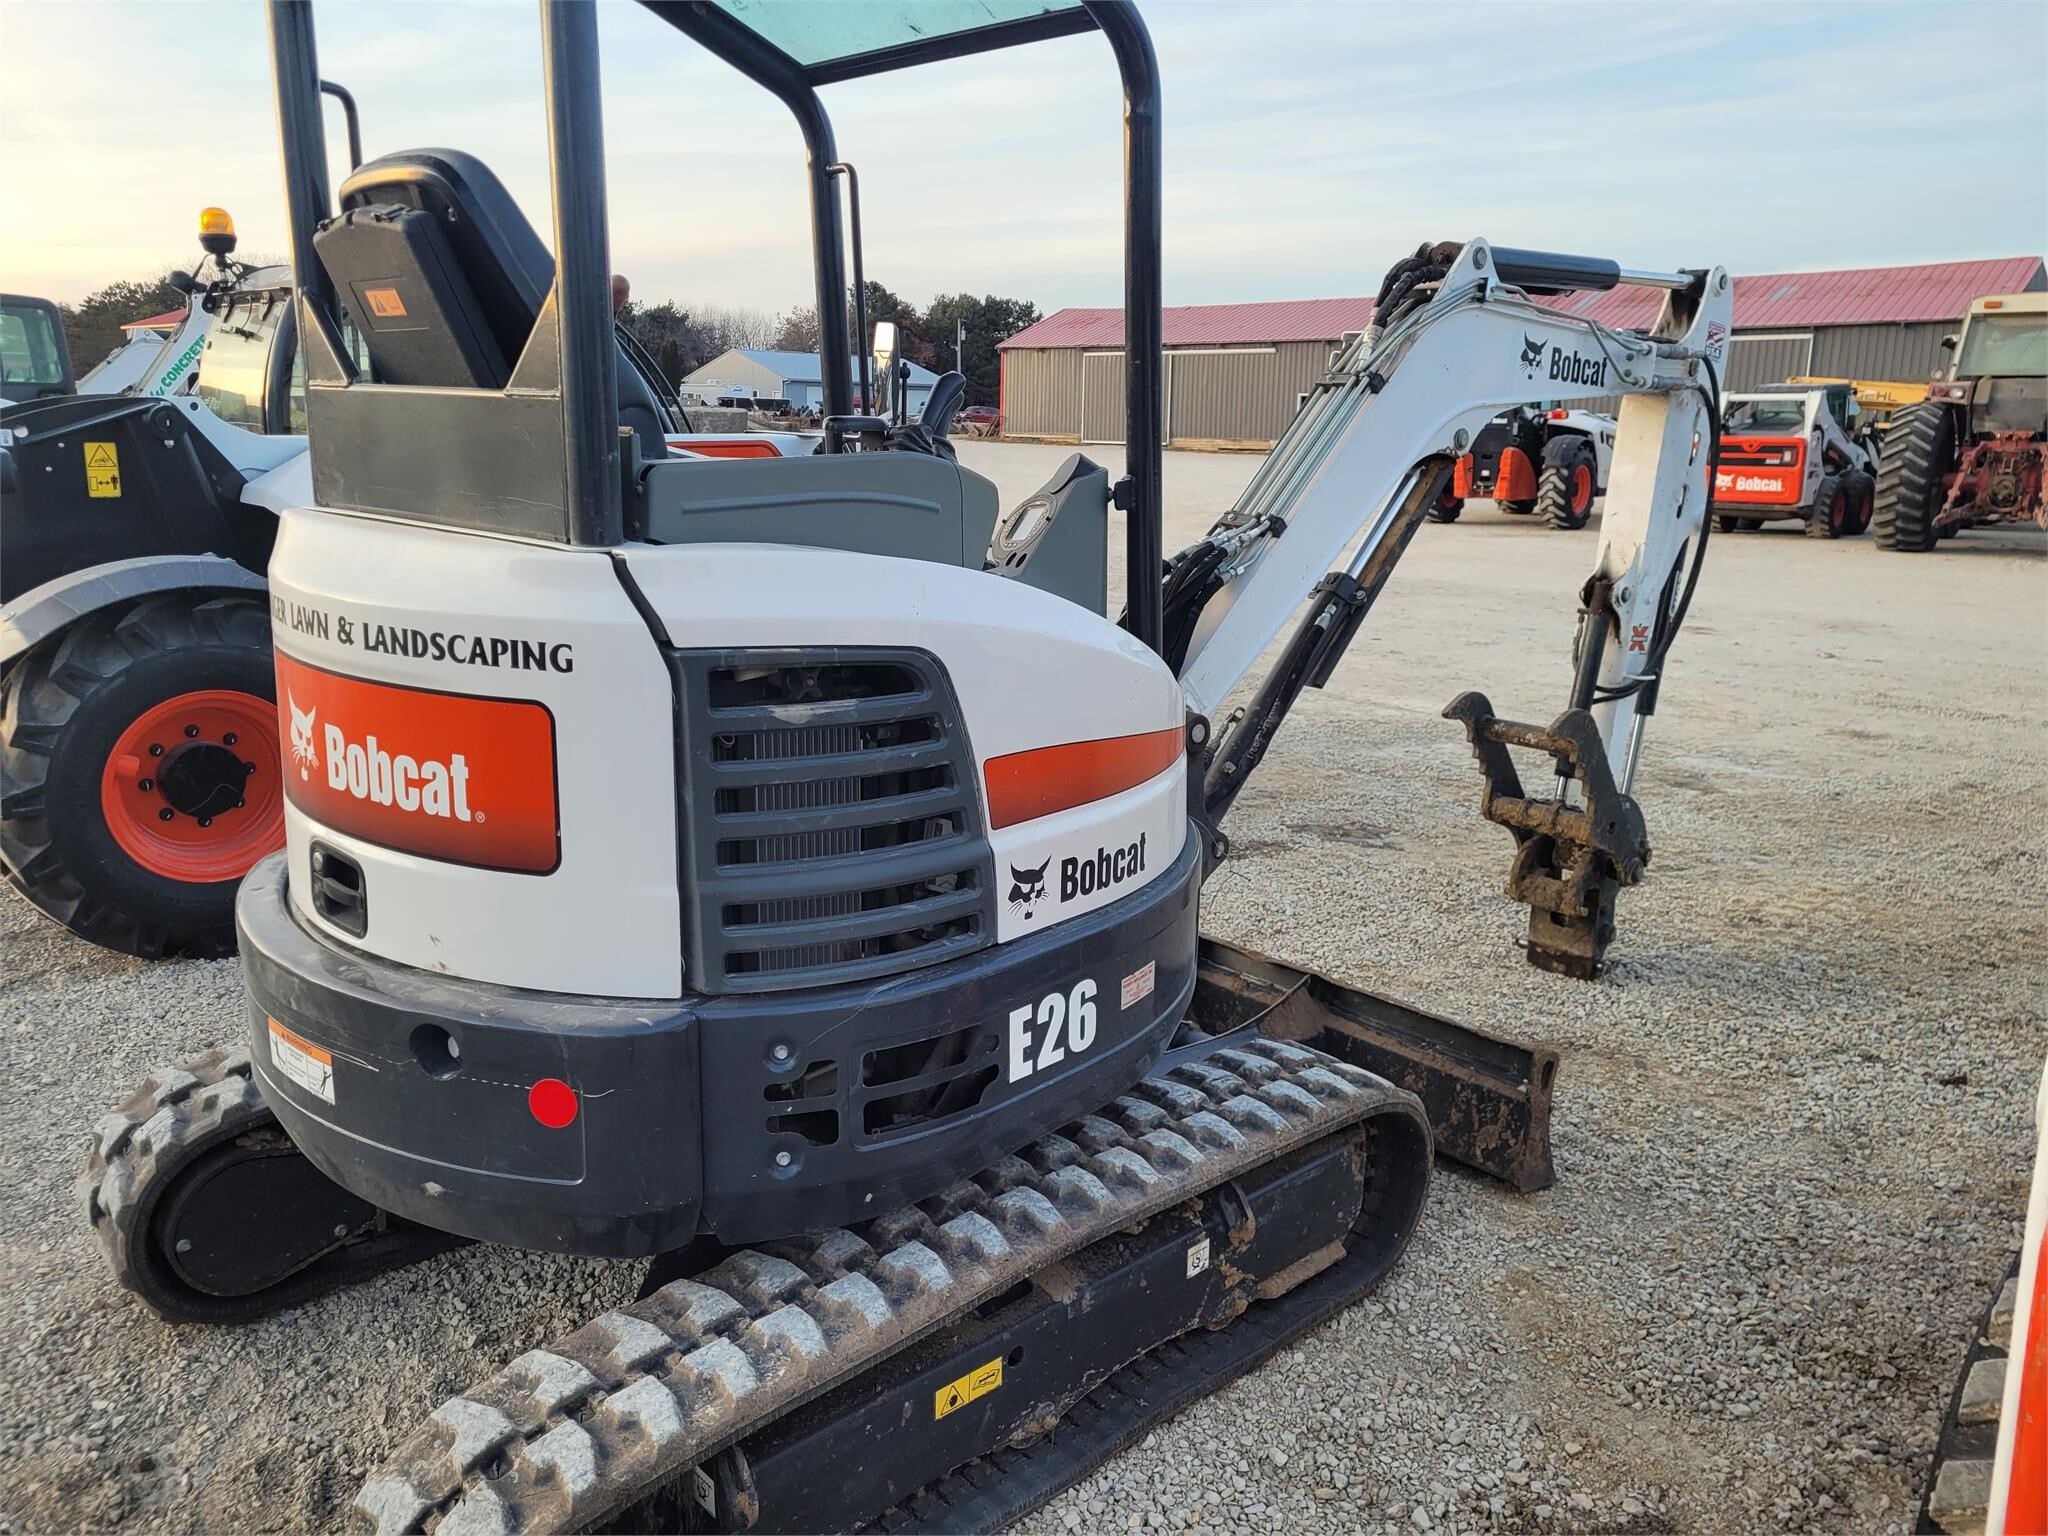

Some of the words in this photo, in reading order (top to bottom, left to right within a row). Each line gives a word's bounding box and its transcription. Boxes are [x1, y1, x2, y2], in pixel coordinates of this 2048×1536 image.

[1549, 347, 1607, 388] Bobcat
[1736, 475, 1782, 492] Bobcat
[290, 602, 329, 641] LAWN
[337, 615, 355, 646] &
[363, 622, 574, 673] LANDSCAPING
[324, 722, 471, 823] Bobcat
[1060, 832, 1146, 903] Bobcat
[1009, 978, 1098, 1084] E26
